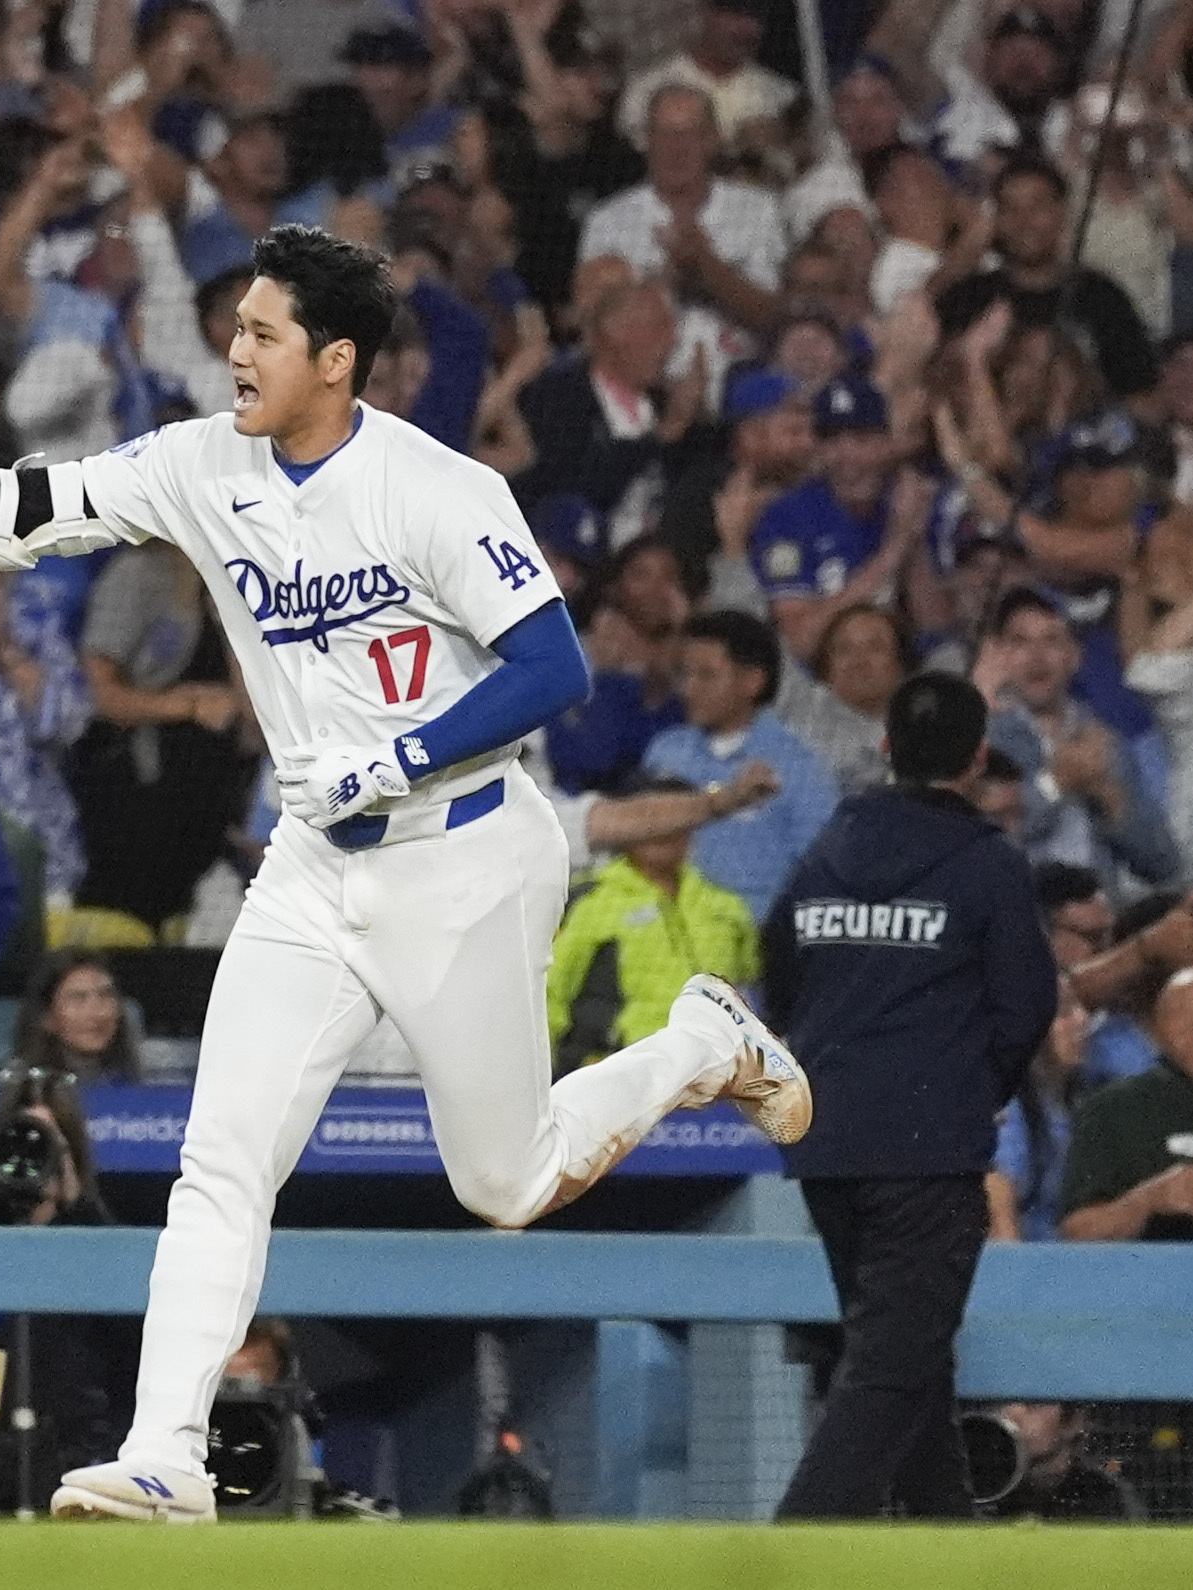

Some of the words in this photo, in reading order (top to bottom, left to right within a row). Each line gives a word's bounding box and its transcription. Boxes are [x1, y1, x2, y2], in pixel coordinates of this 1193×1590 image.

[477, 534, 541, 591] LA
[224, 558, 410, 653] Dodgers
[367, 625, 432, 705] 17
